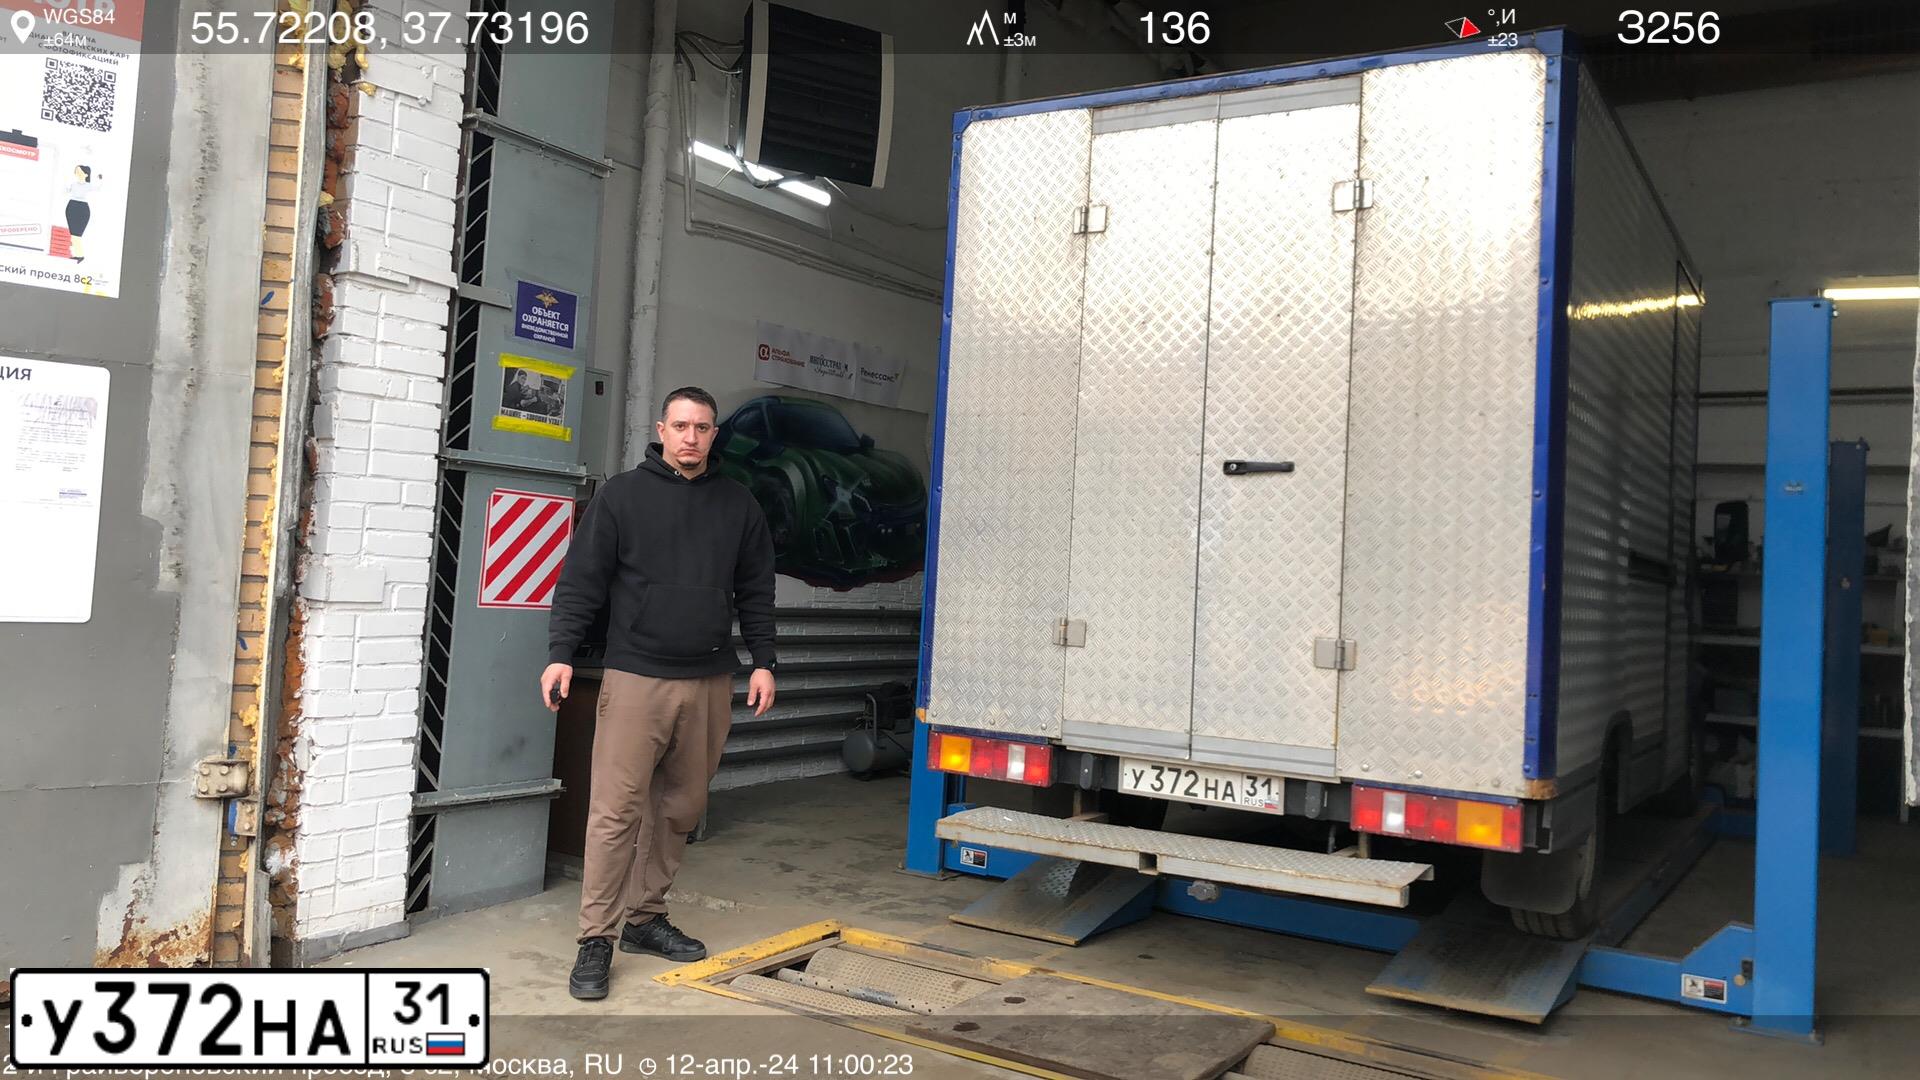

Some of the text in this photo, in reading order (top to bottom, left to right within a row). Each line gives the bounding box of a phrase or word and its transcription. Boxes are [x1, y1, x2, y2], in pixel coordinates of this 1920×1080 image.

[30, 268, 71, 284] проезд
[531, 306, 561, 320] ОБЪЕКТ
[521, 313, 569, 332] ОХРАНЯЕТСЯ
[1131, 764, 1273, 803] У372НА 31
[1243, 798, 1264, 807] RUS
